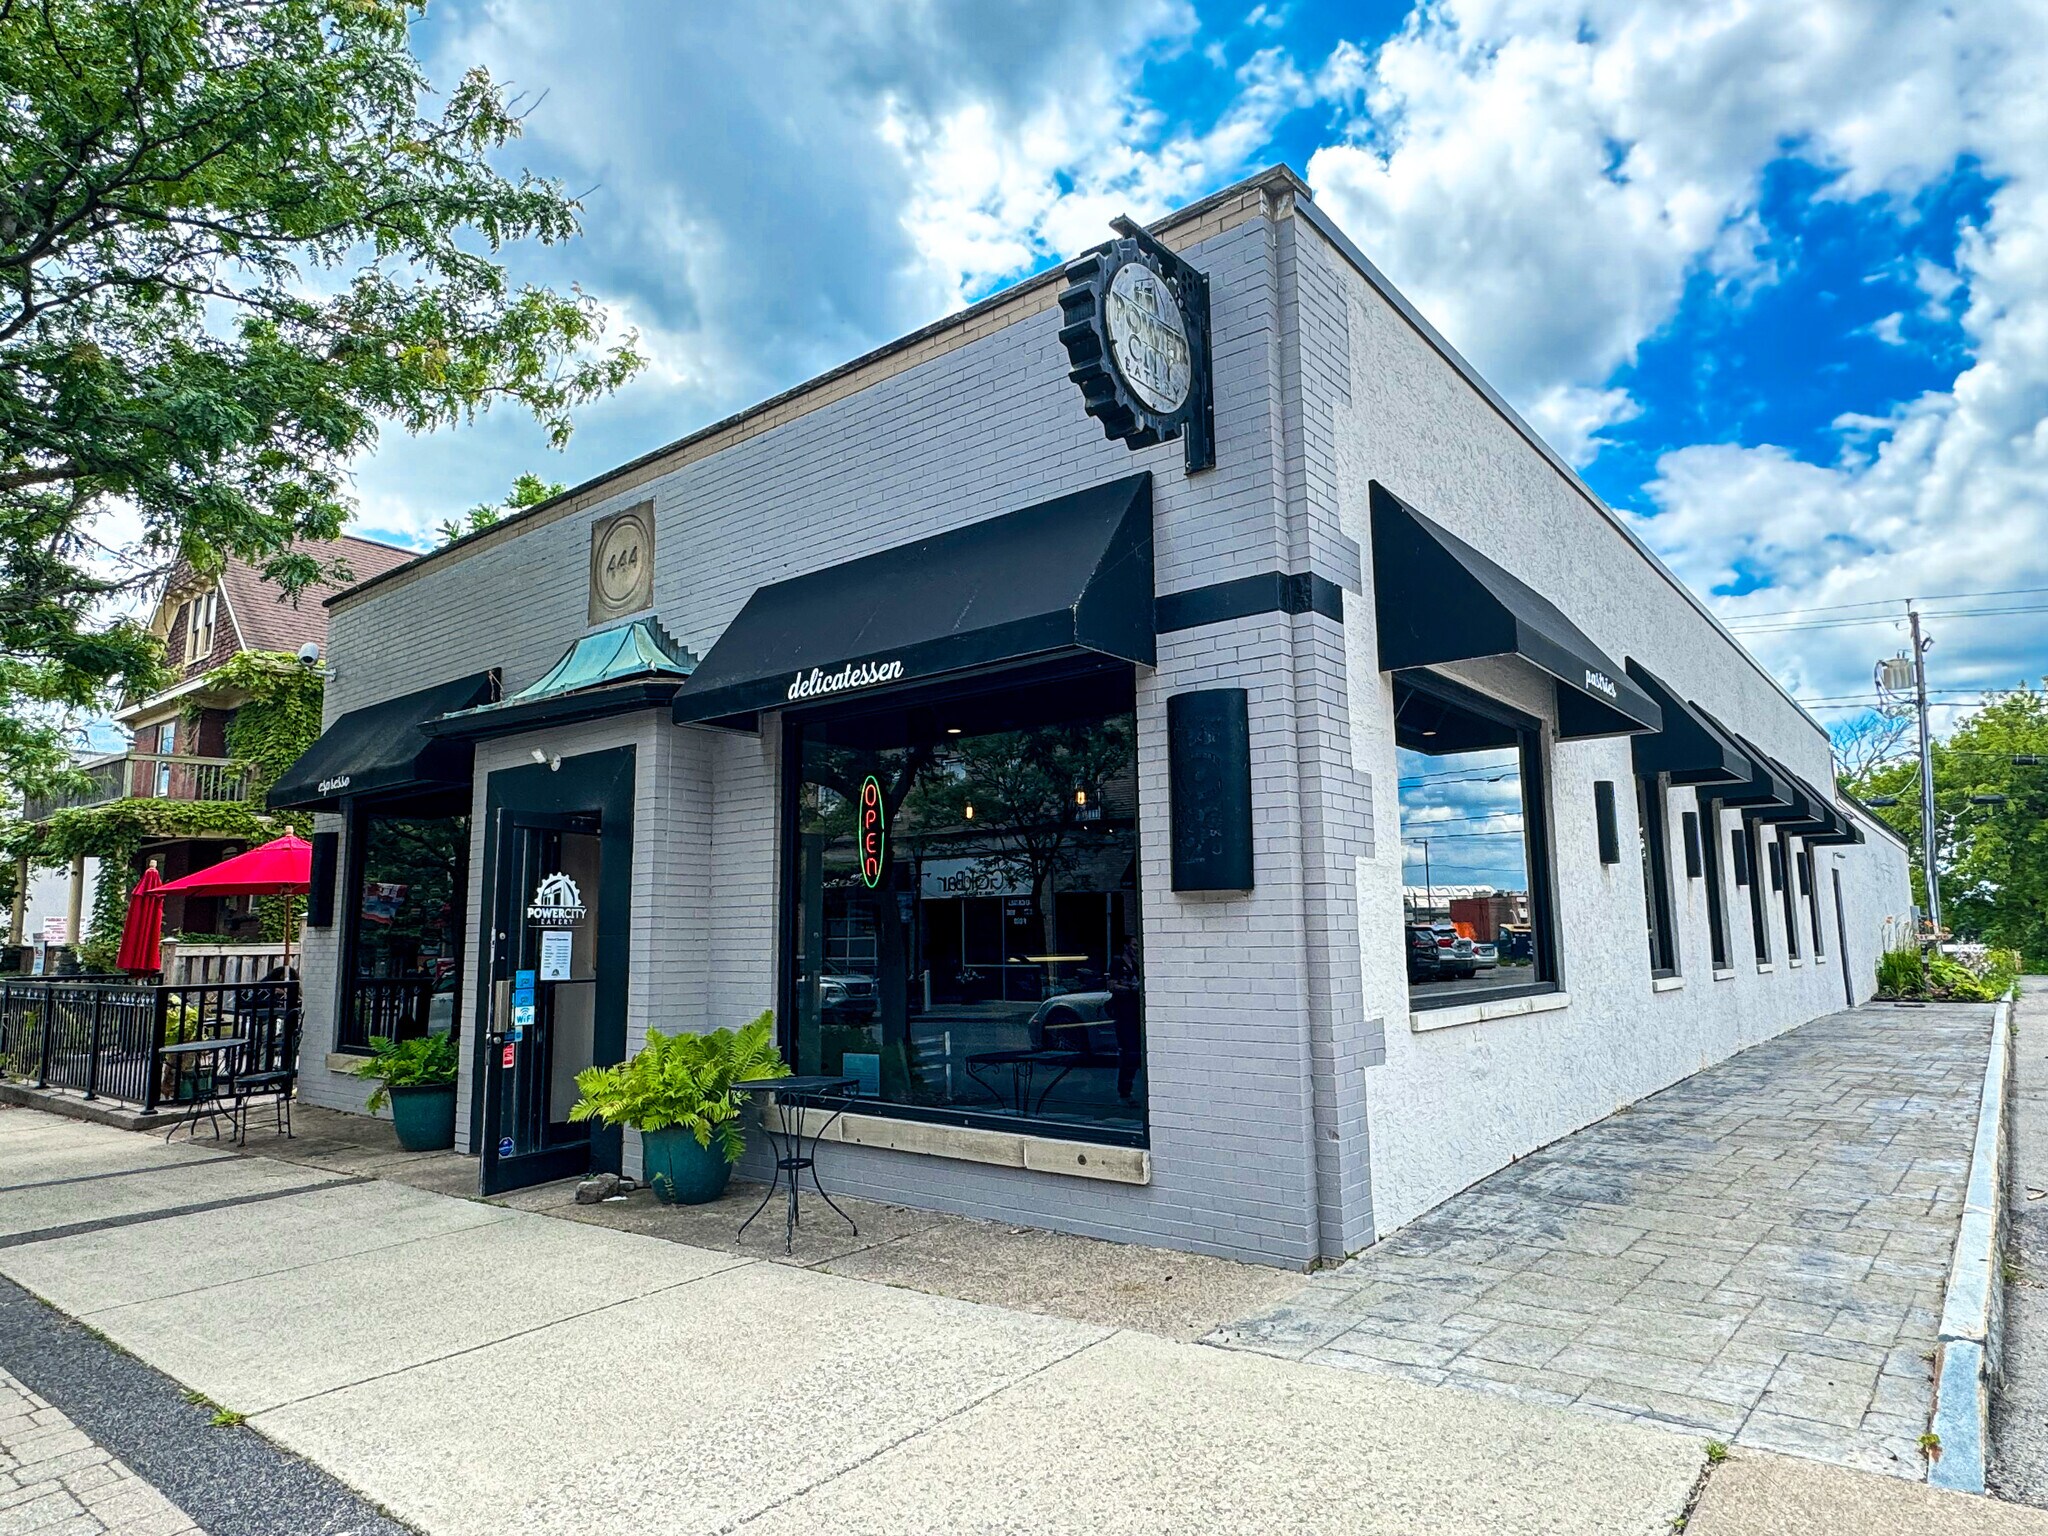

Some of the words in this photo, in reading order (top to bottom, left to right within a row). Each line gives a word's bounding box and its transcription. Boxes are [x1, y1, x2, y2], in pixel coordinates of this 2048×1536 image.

[1112, 291, 1188, 366] POWER
[1125, 356, 1180, 397] EATERY
[1128, 333, 1172, 382] CITY
[606, 545, 638, 580] 444
[787, 660, 904, 700] delicatessen
[1585, 669, 1617, 698] pastries
[317, 775, 351, 797] espresso
[865, 784, 877, 877] OPEN
